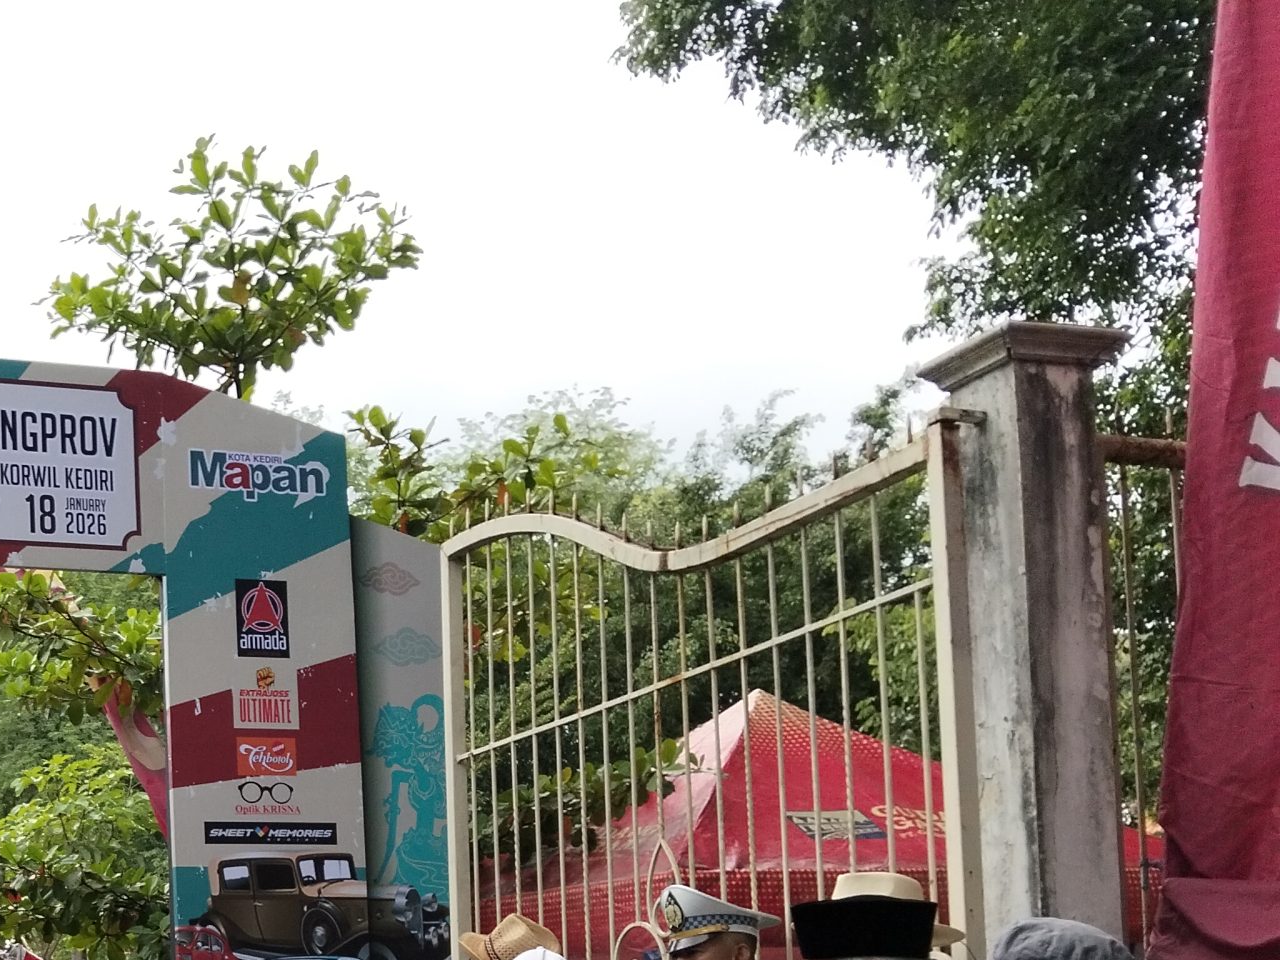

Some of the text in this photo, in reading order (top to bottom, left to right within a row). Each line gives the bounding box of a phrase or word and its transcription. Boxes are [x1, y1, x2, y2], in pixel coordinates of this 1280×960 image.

[228, 453, 282, 464] KOTA KEDIRI
[0, 463, 114, 492] KORWIL KEDIRI
[189, 449, 325, 500] Mapan
[25, 493, 56, 535] 18
[65, 497, 106, 513] JANUARY
[65, 512, 107, 536] 2026
[240, 631, 287, 650] armada
[240, 698, 292, 724] ULTIMATE
[235, 804, 301, 816] Optik KRISNA
[209, 828, 333, 838] SWEET MEMORIES
